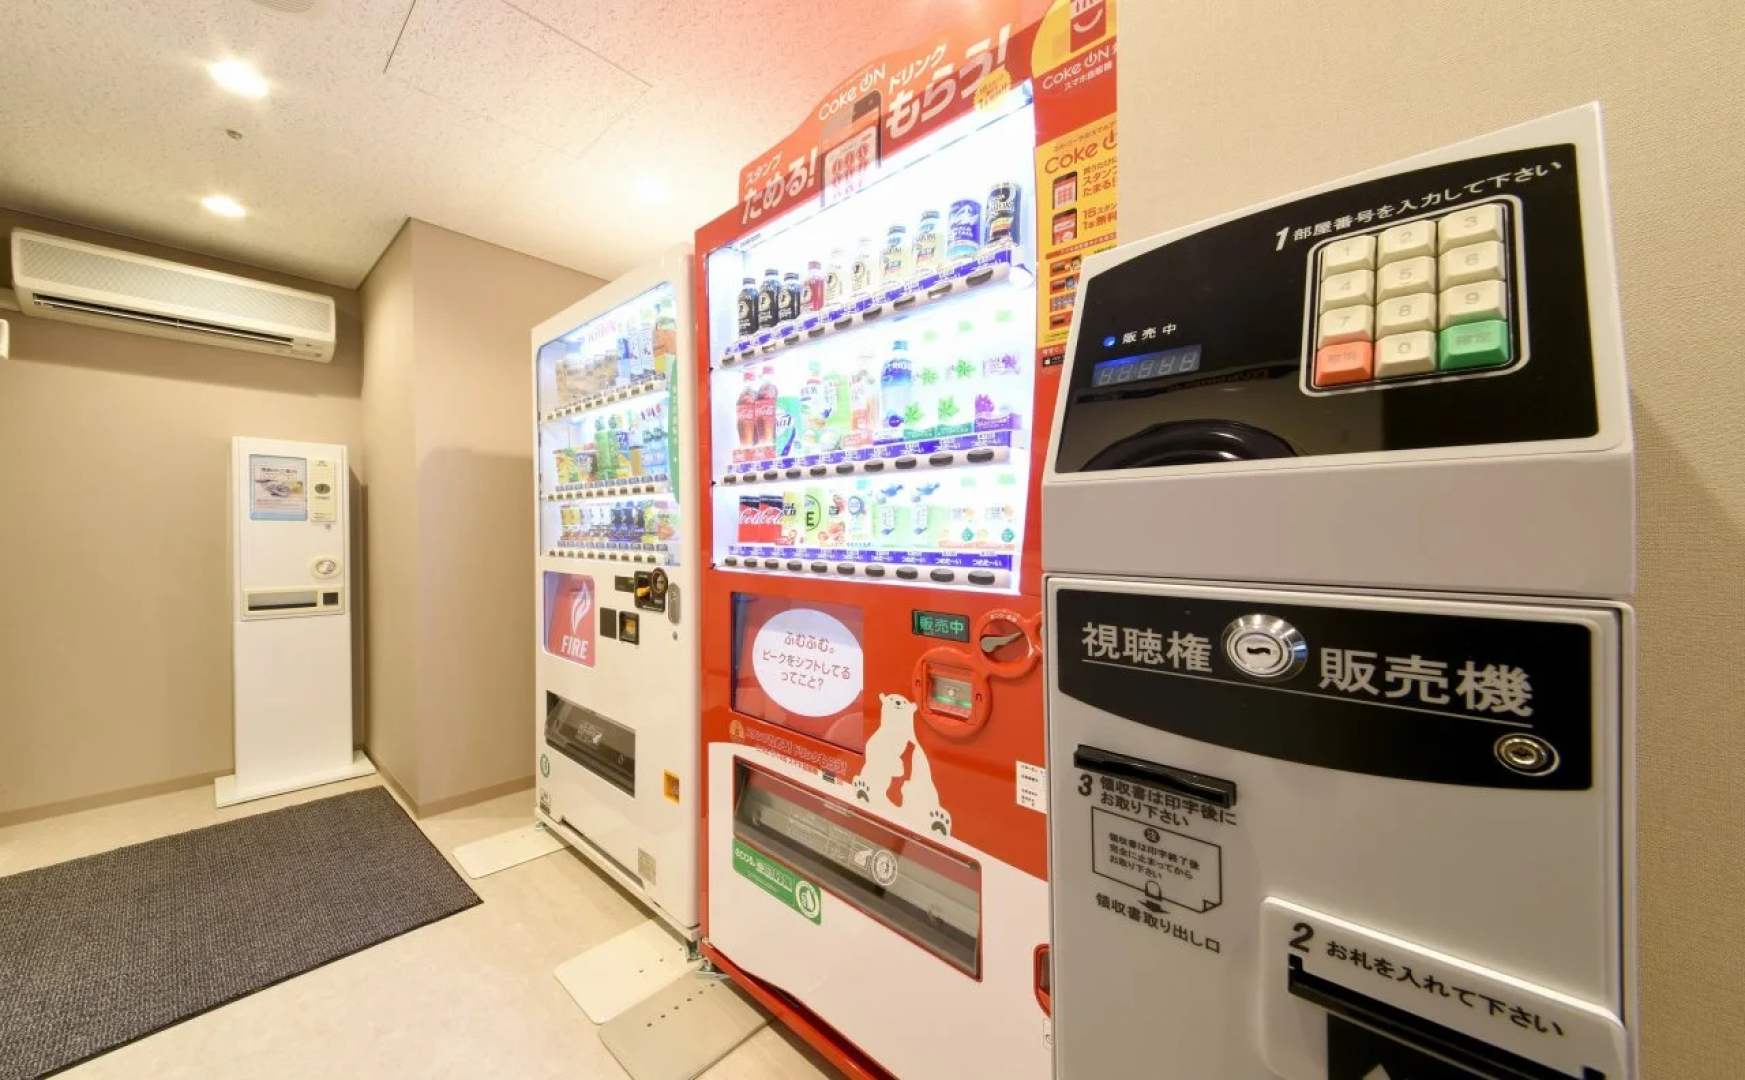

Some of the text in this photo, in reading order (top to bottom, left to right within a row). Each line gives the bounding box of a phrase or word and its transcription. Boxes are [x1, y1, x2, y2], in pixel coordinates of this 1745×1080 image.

[888, 43, 947, 95] ドリンク
[1042, 62, 1082, 90] Coke
[818, 86, 857, 121] Coke
[745, 150, 783, 187] スタンプ
[1045, 142, 1098, 174] Coke
[741, 146, 819, 225] ためる!
[1274, 161, 1562, 251] 1 部屋番号を入力して下さい
[1464, 215, 1479, 229] 3
[1399, 267, 1413, 281] 5
[1465, 252, 1480, 266] 6
[1465, 291, 1480, 305] 9
[1122, 323, 1178, 344] 販売中
[784, 631, 835, 654] ふむふむ。
[919, 616, 965, 635] 販売中
[561, 635, 589, 659] FIRE
[1081, 621, 1534, 718] 視聴権 販売機
[1077, 774, 1093, 797] 3
[1100, 775, 1238, 826] 領収書は印字後に
[1100, 792, 1190, 827] お取り下さい
[1096, 892, 1220, 954] 領収書取り出し口
[1288, 922, 1566, 1037] 2 お札を入れて下さい
